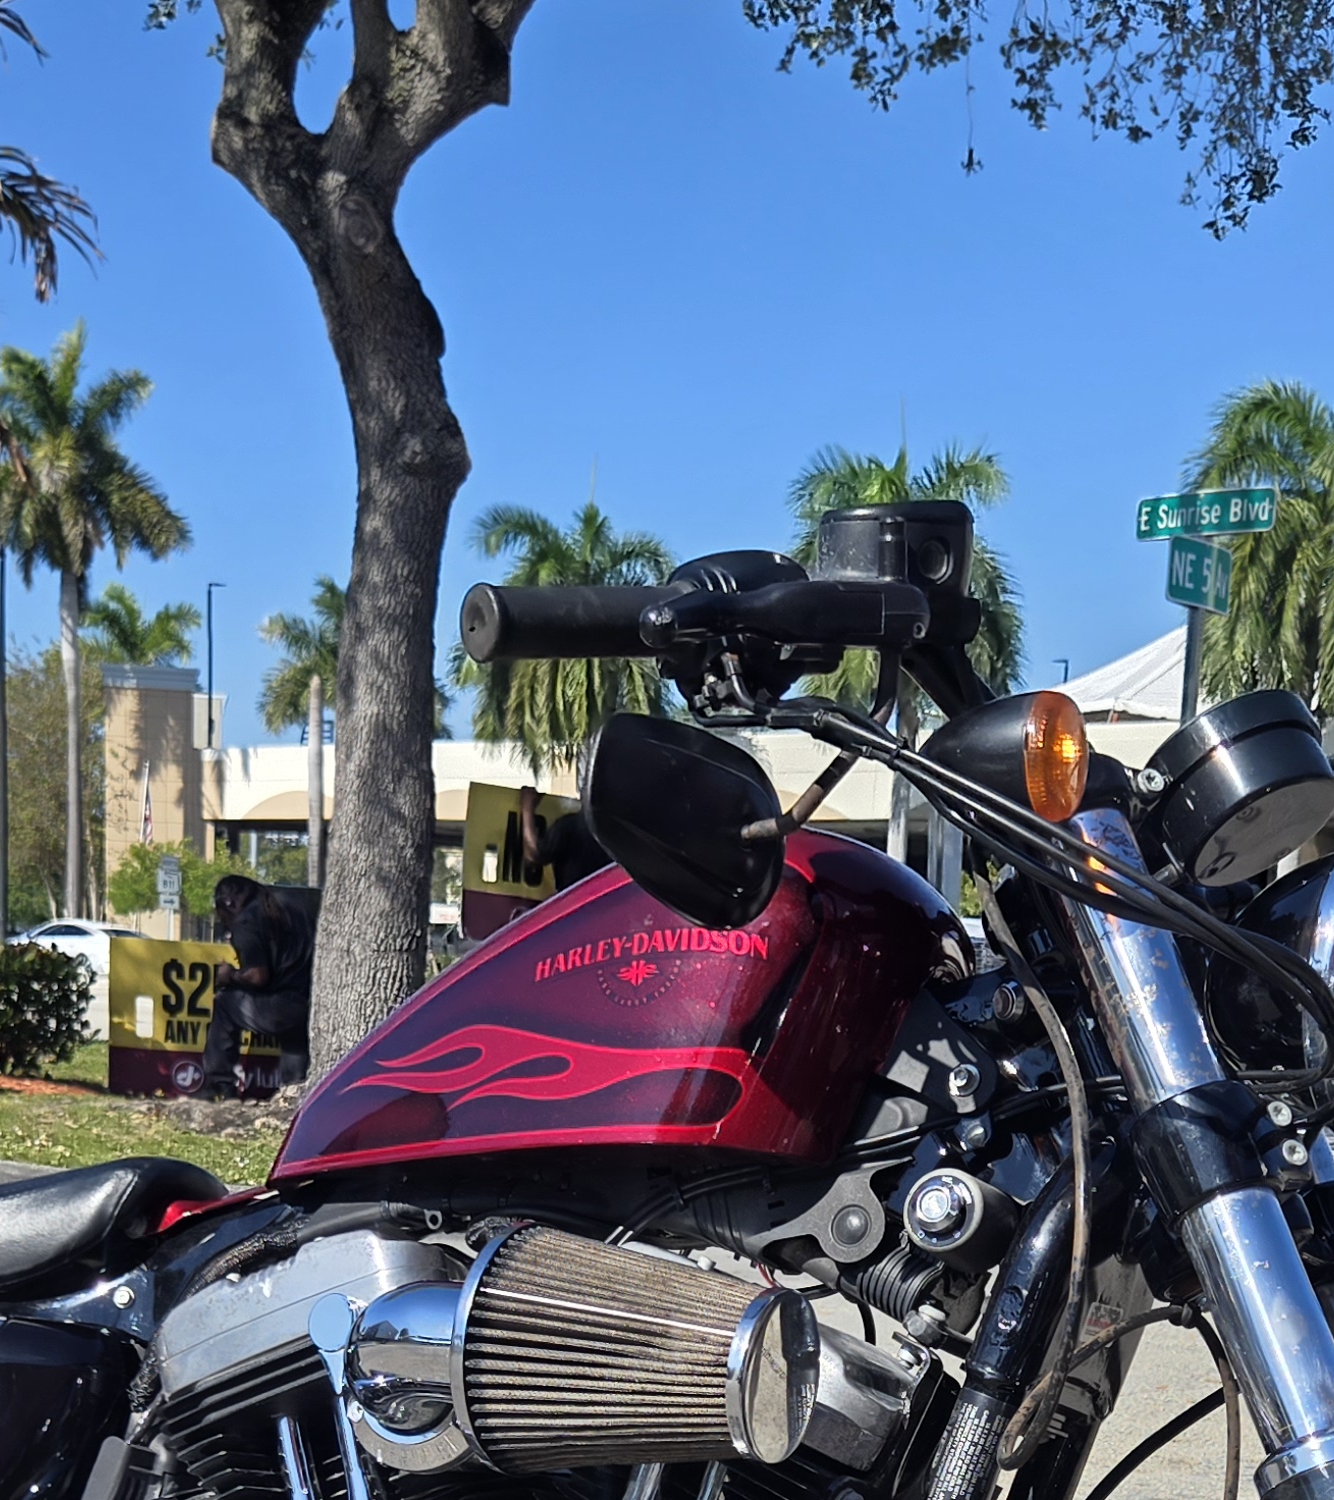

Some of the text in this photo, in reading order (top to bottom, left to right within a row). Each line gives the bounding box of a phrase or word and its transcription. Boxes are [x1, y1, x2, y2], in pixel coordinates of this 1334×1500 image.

[1139, 497, 1271, 531] E Sunrise Blvd
[1171, 550, 1196, 590] NE
[1201, 557, 1212, 594] 5
[534, 926, 769, 984] HARLEY-DAVIDSON
[162, 957, 222, 1018] $2
[165, 1019, 202, 1045] ANY
